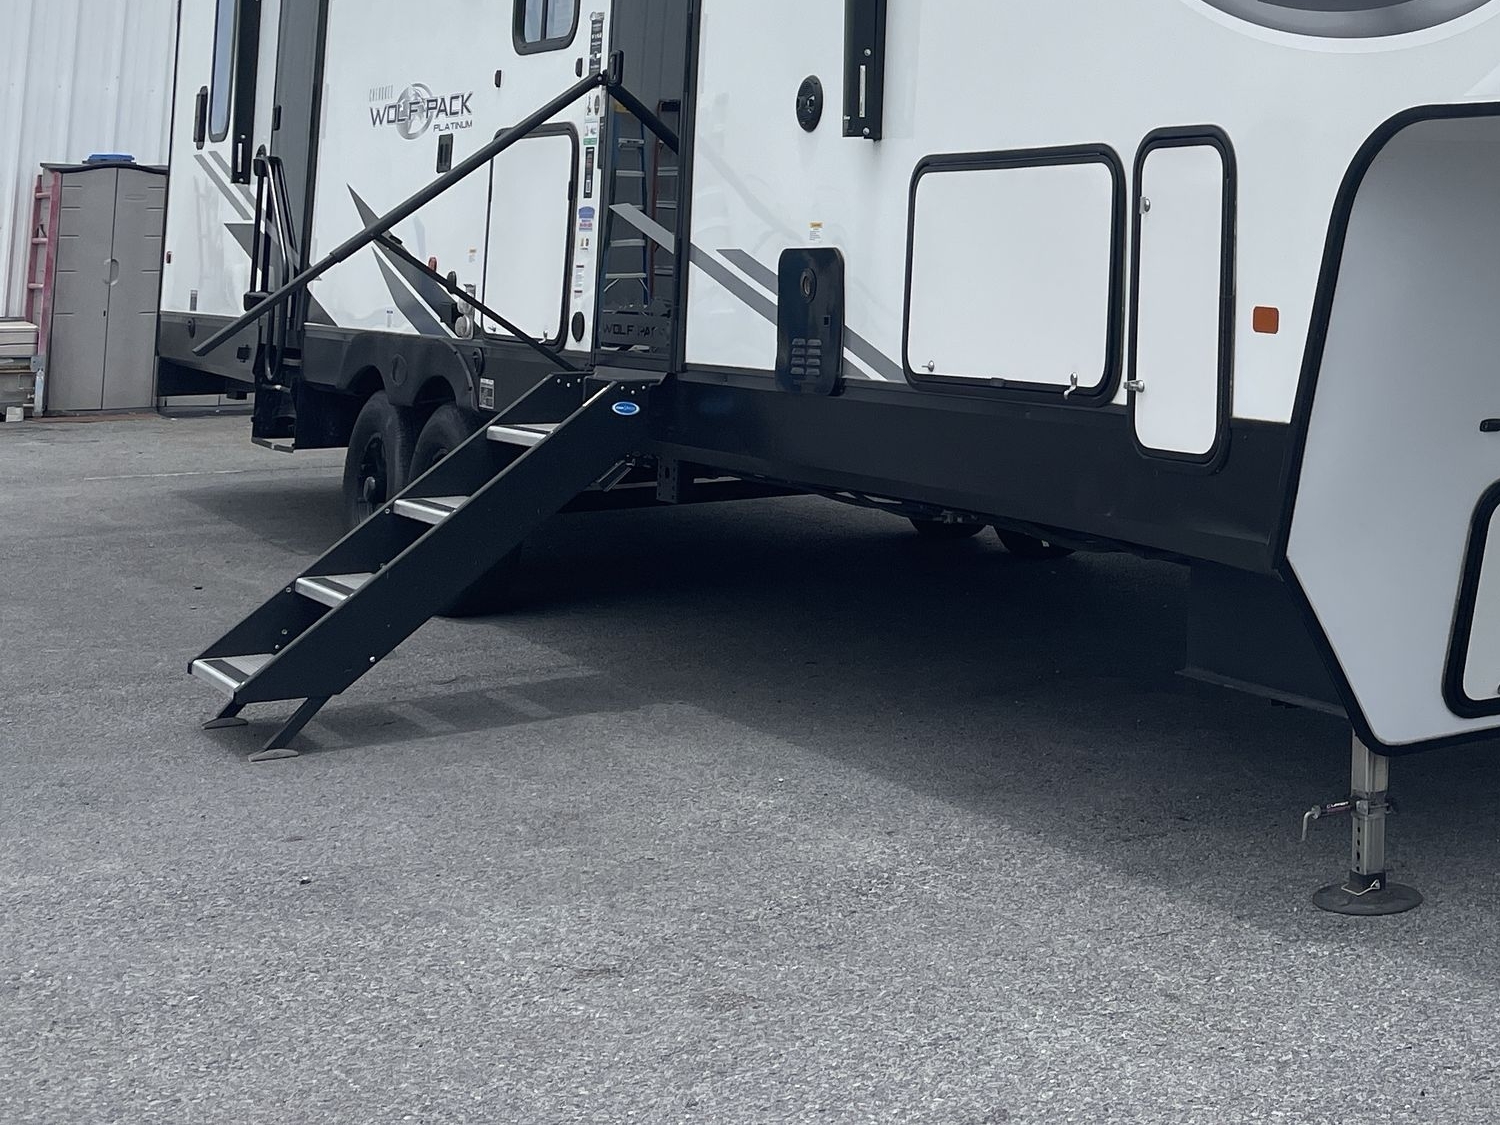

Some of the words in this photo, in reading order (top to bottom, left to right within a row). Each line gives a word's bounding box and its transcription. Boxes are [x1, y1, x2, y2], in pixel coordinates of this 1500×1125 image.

[369, 100, 421, 128] WOLF
[425, 91, 473, 119] PACK
[432, 120, 473, 132] PLATINUM
